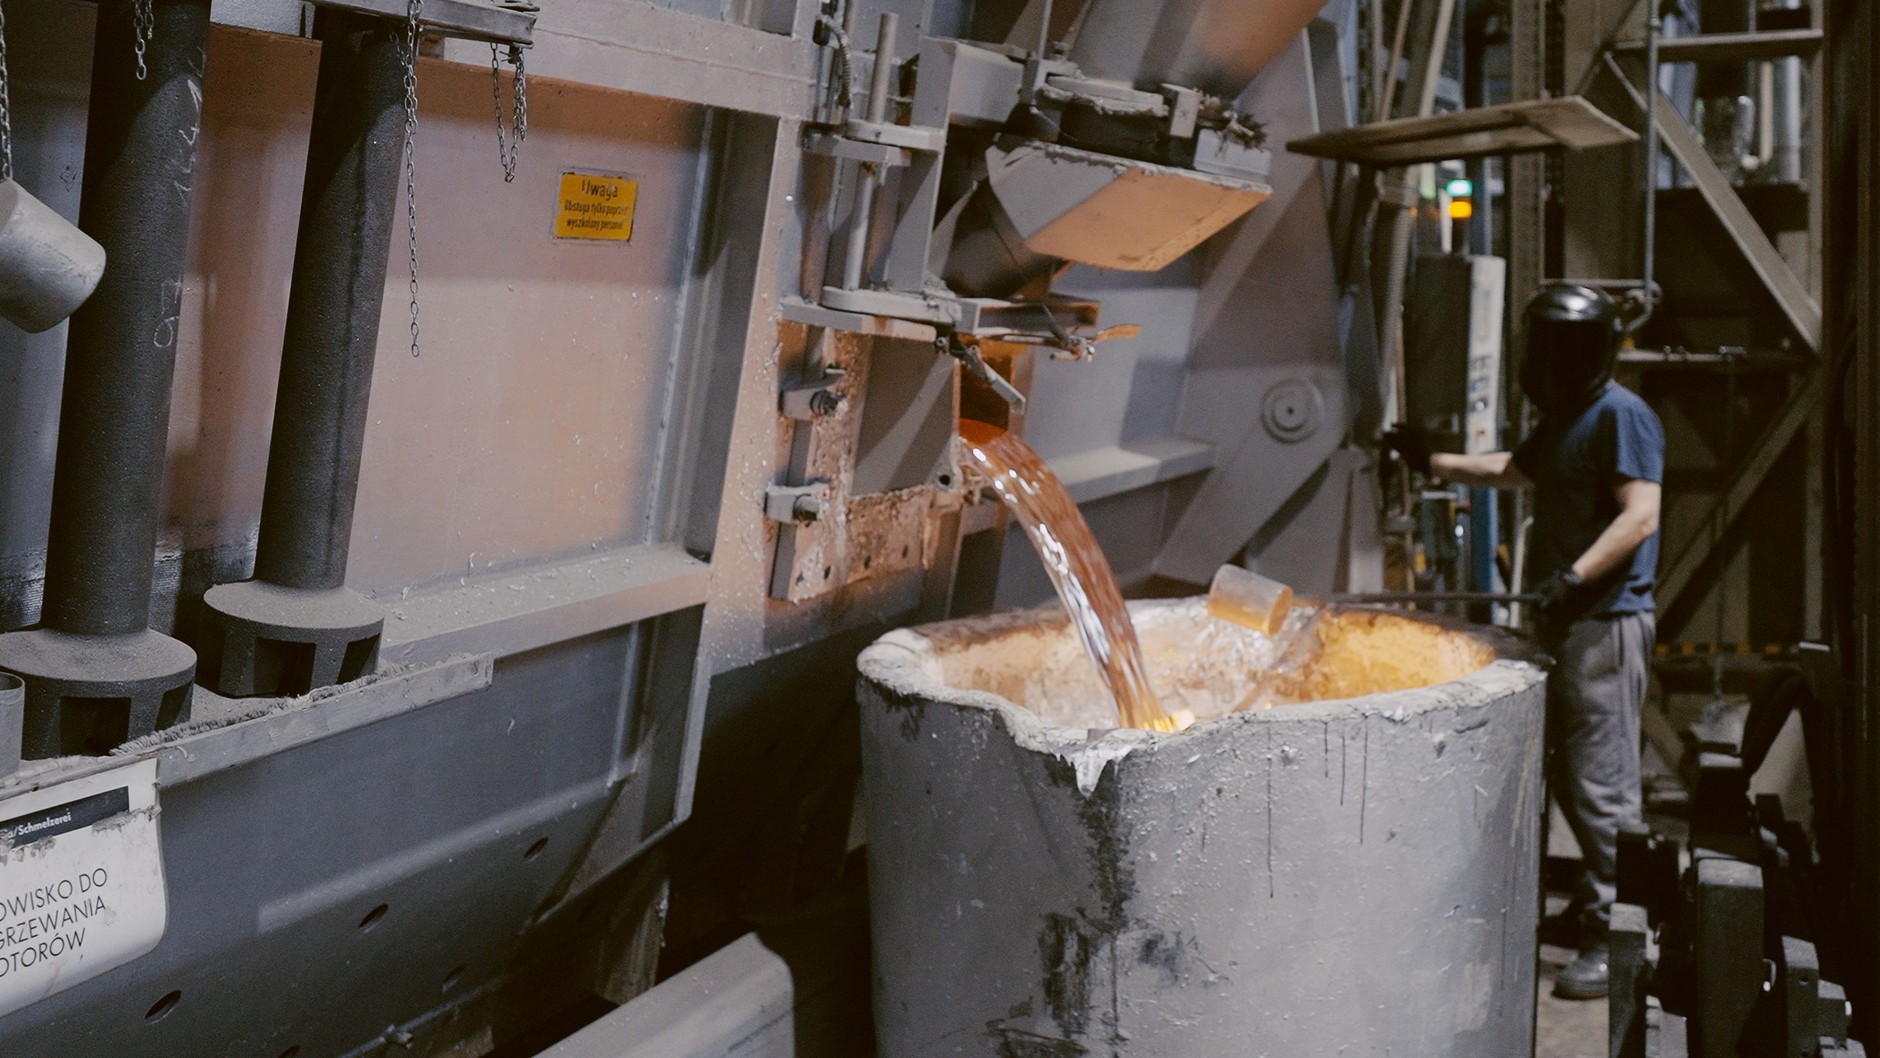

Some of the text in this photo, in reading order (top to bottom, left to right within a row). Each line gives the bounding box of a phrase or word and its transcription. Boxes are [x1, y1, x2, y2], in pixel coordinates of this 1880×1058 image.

[581, 180, 618, 201] Uwaga
[0, 811, 72, 839] a/Schmelzerei
[79, 867, 108, 893] DO
